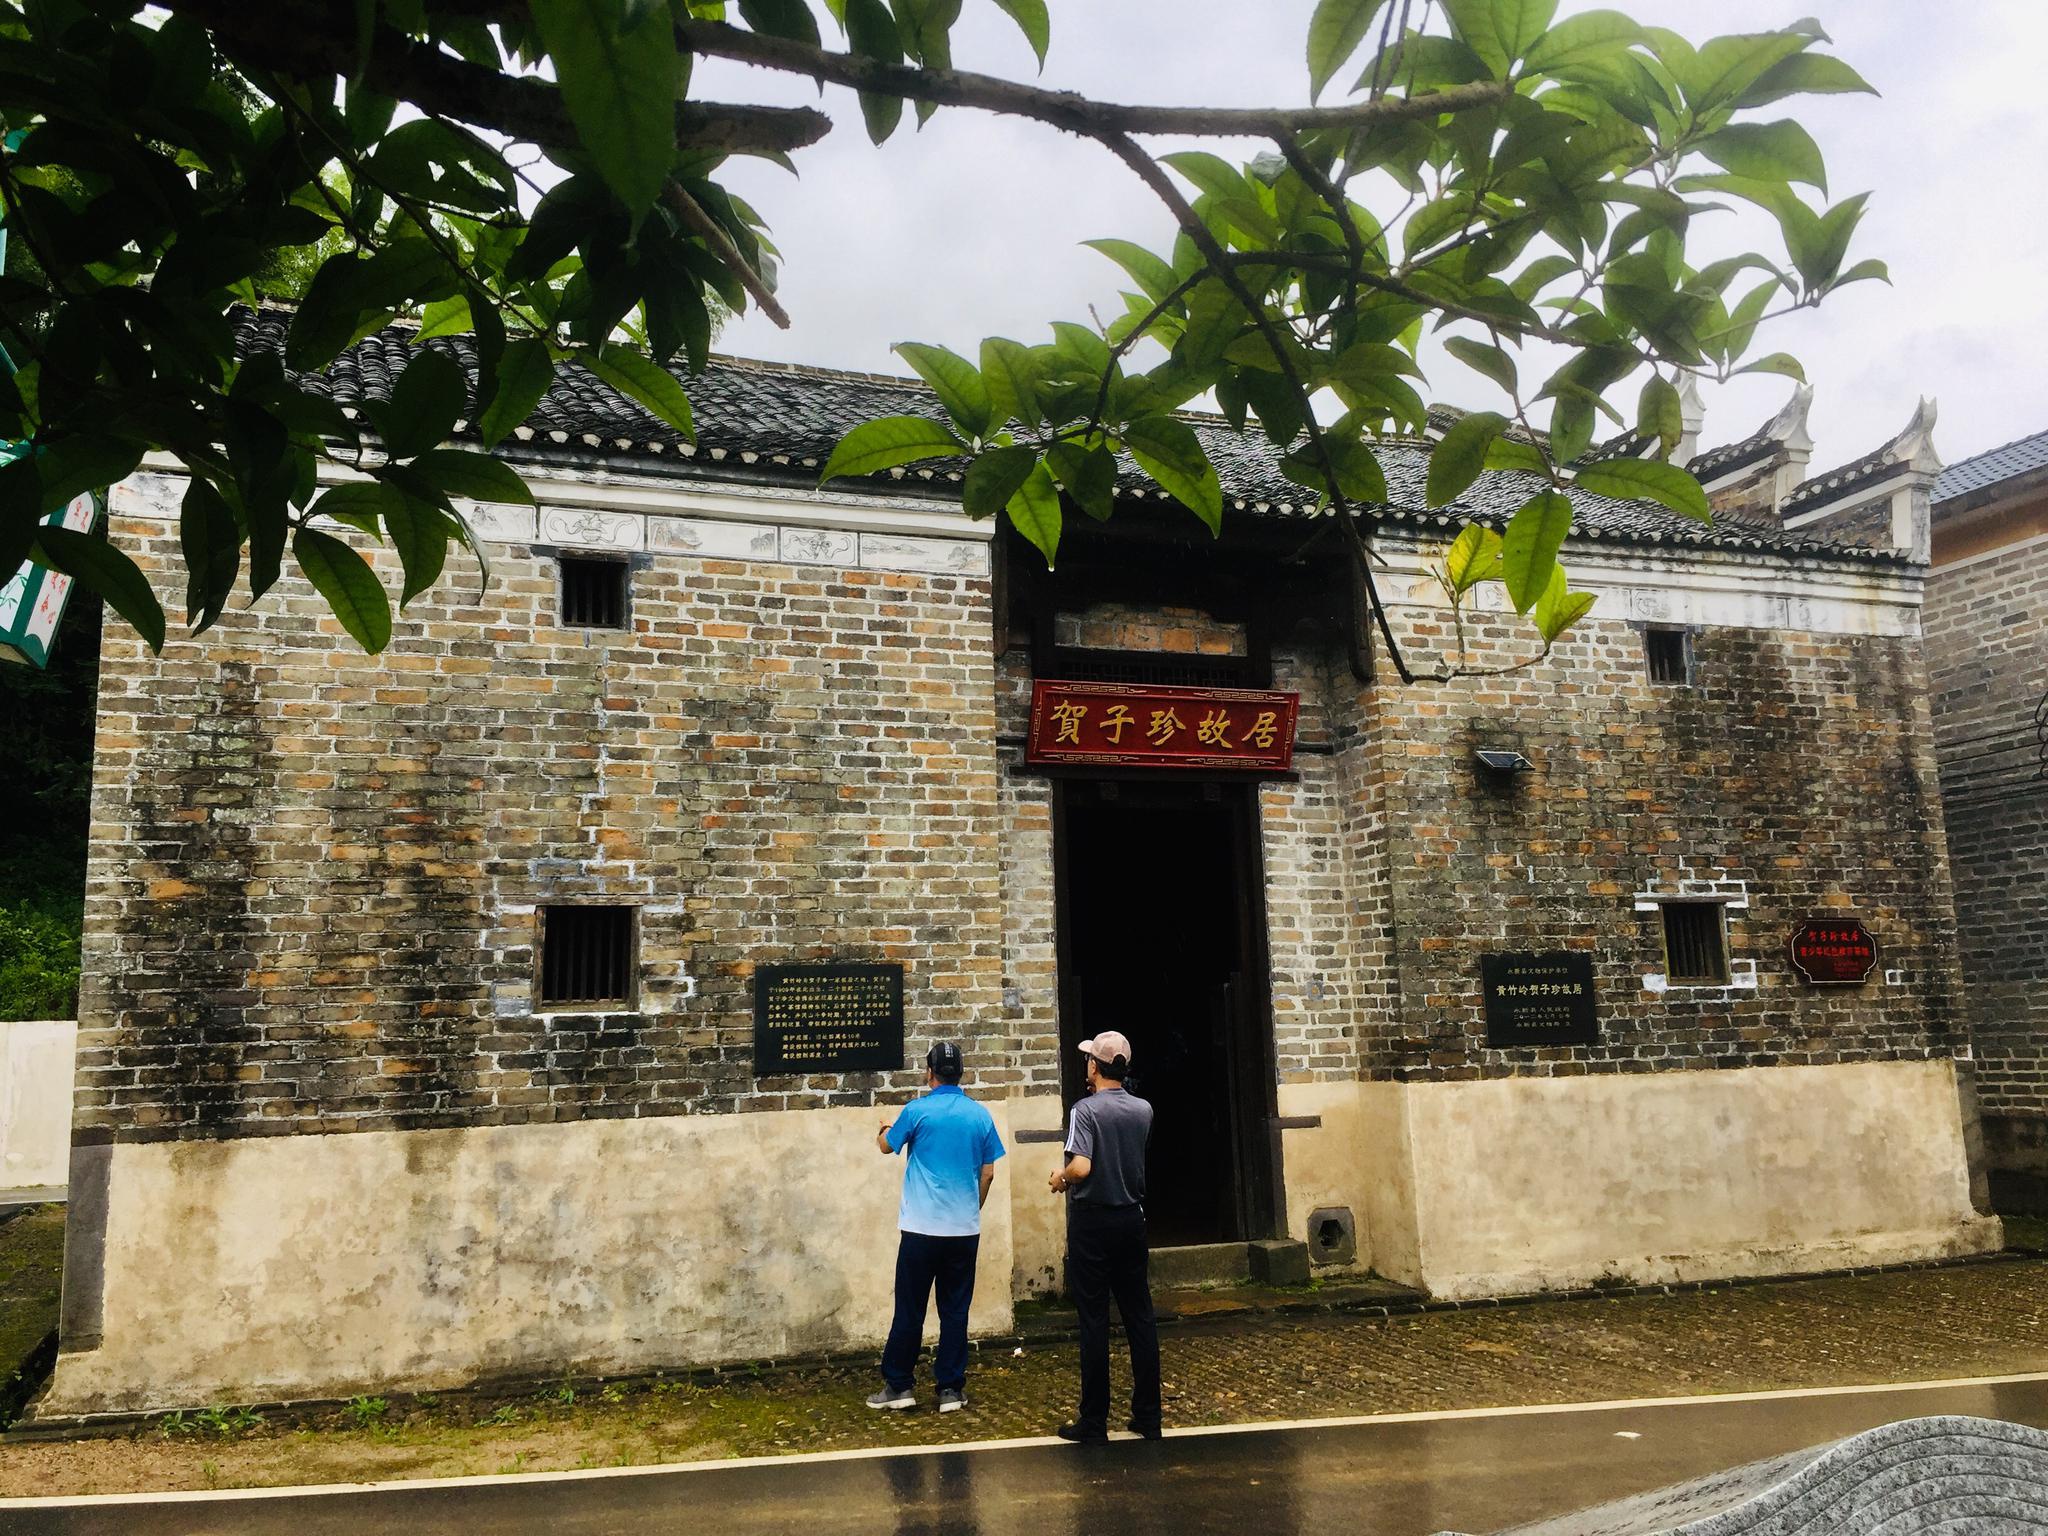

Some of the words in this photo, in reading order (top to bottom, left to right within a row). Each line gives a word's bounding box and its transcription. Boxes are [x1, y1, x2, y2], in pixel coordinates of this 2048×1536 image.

[1050, 700, 1278, 749] 賀子珍故居
[1496, 984, 1582, 996] 黄竹岭贺子珍故居
